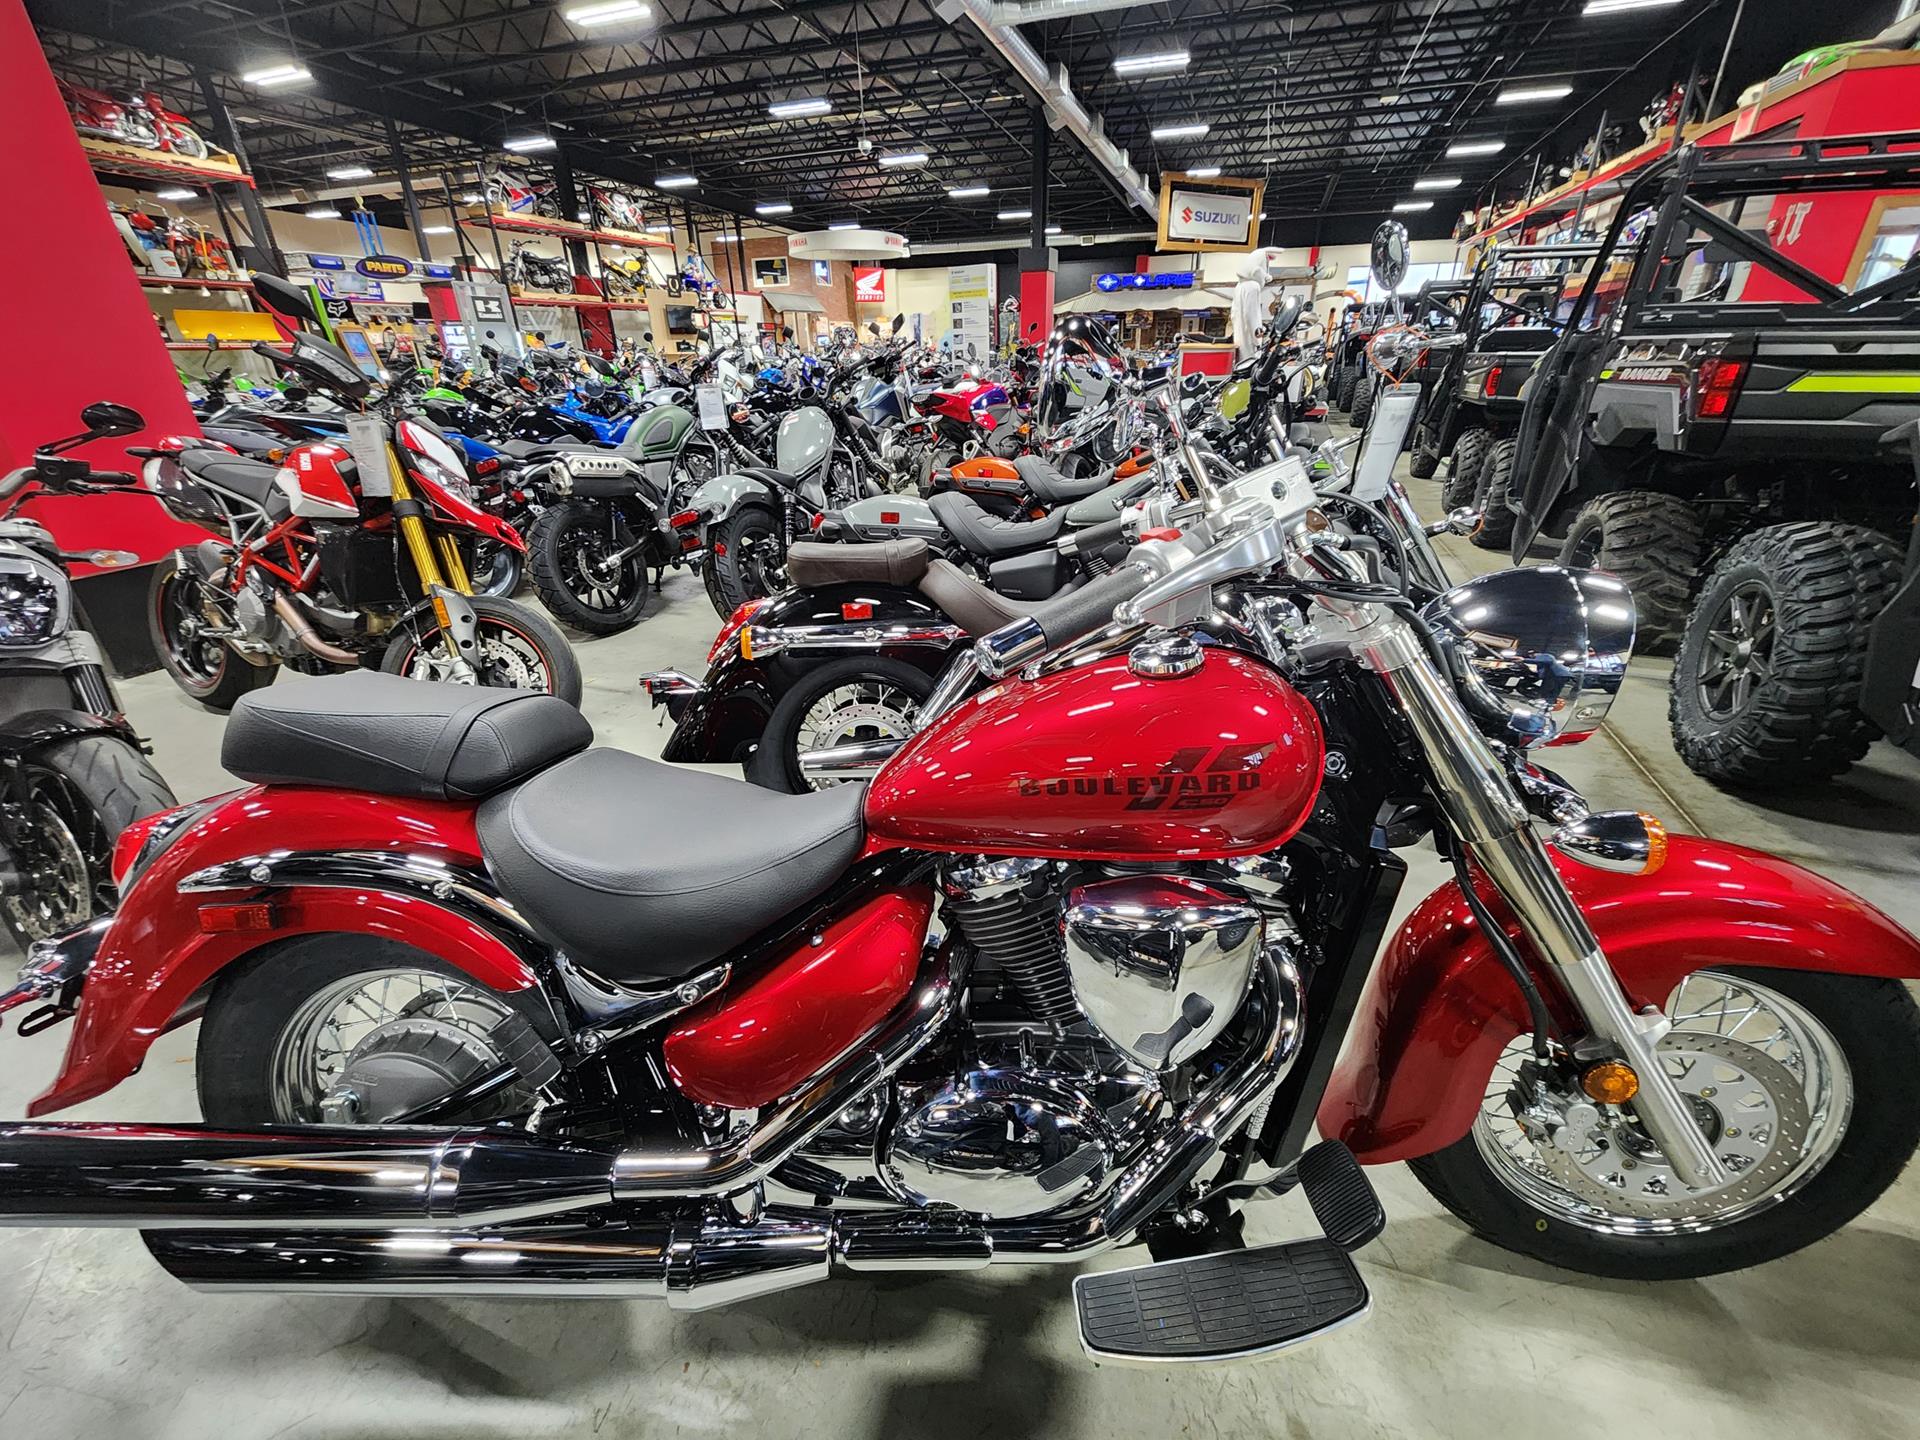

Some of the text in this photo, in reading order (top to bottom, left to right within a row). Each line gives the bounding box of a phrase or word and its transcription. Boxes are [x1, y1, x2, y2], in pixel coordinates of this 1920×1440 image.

[1194, 210, 1241, 226] SUZUKI
[364, 260, 407, 274] PARTS
[1121, 272, 1195, 289] POLARIS
[1619, 367, 1673, 381] RANGER
[1019, 772, 1261, 797] BOULEVARD
